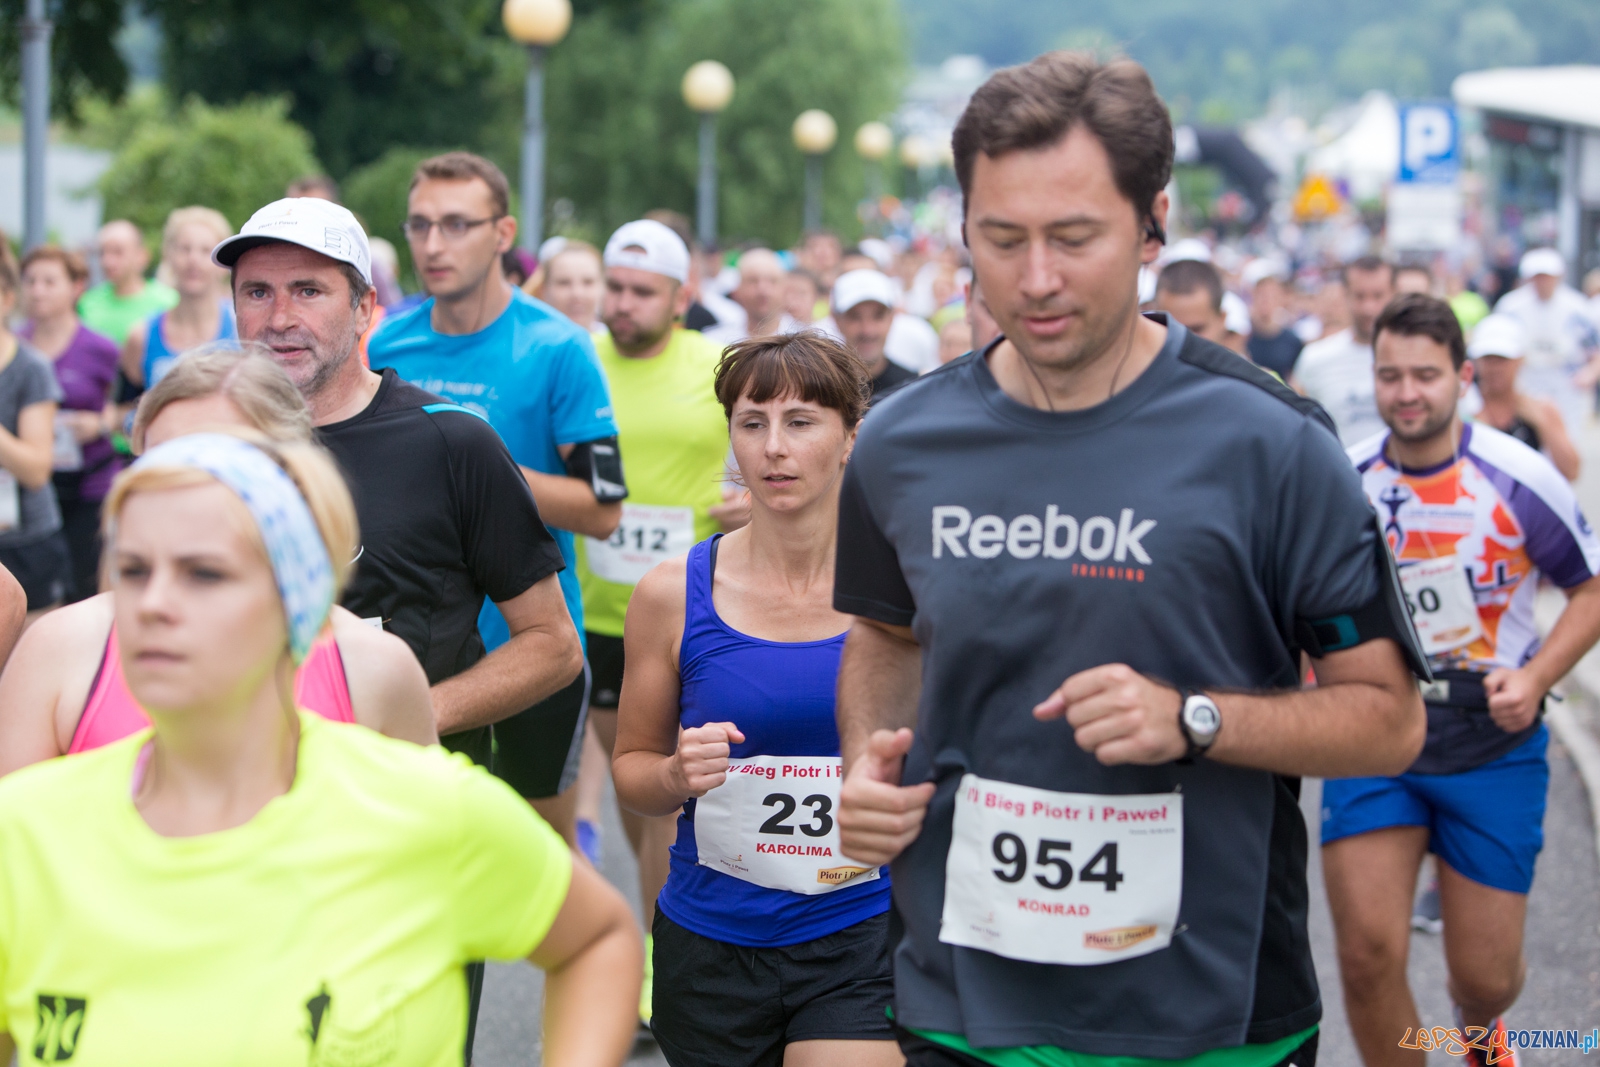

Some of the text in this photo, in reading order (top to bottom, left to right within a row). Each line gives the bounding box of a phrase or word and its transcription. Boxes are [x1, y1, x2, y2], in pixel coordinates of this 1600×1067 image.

[932, 504, 1158, 566] Reebok
[741, 764, 777, 779] Bieg
[782, 764, 821, 778] Piotr
[826, 764, 831, 778] i
[758, 792, 834, 838] 23
[984, 791, 1026, 818] Bieg
[1031, 800, 1083, 822] Piotr
[1088, 803, 1095, 822] i
[756, 842, 833, 858] KAROLIMA
[991, 831, 1125, 893] 954
[820, 871, 842, 879] Piotr
[1017, 897, 1091, 917] KONRAD
